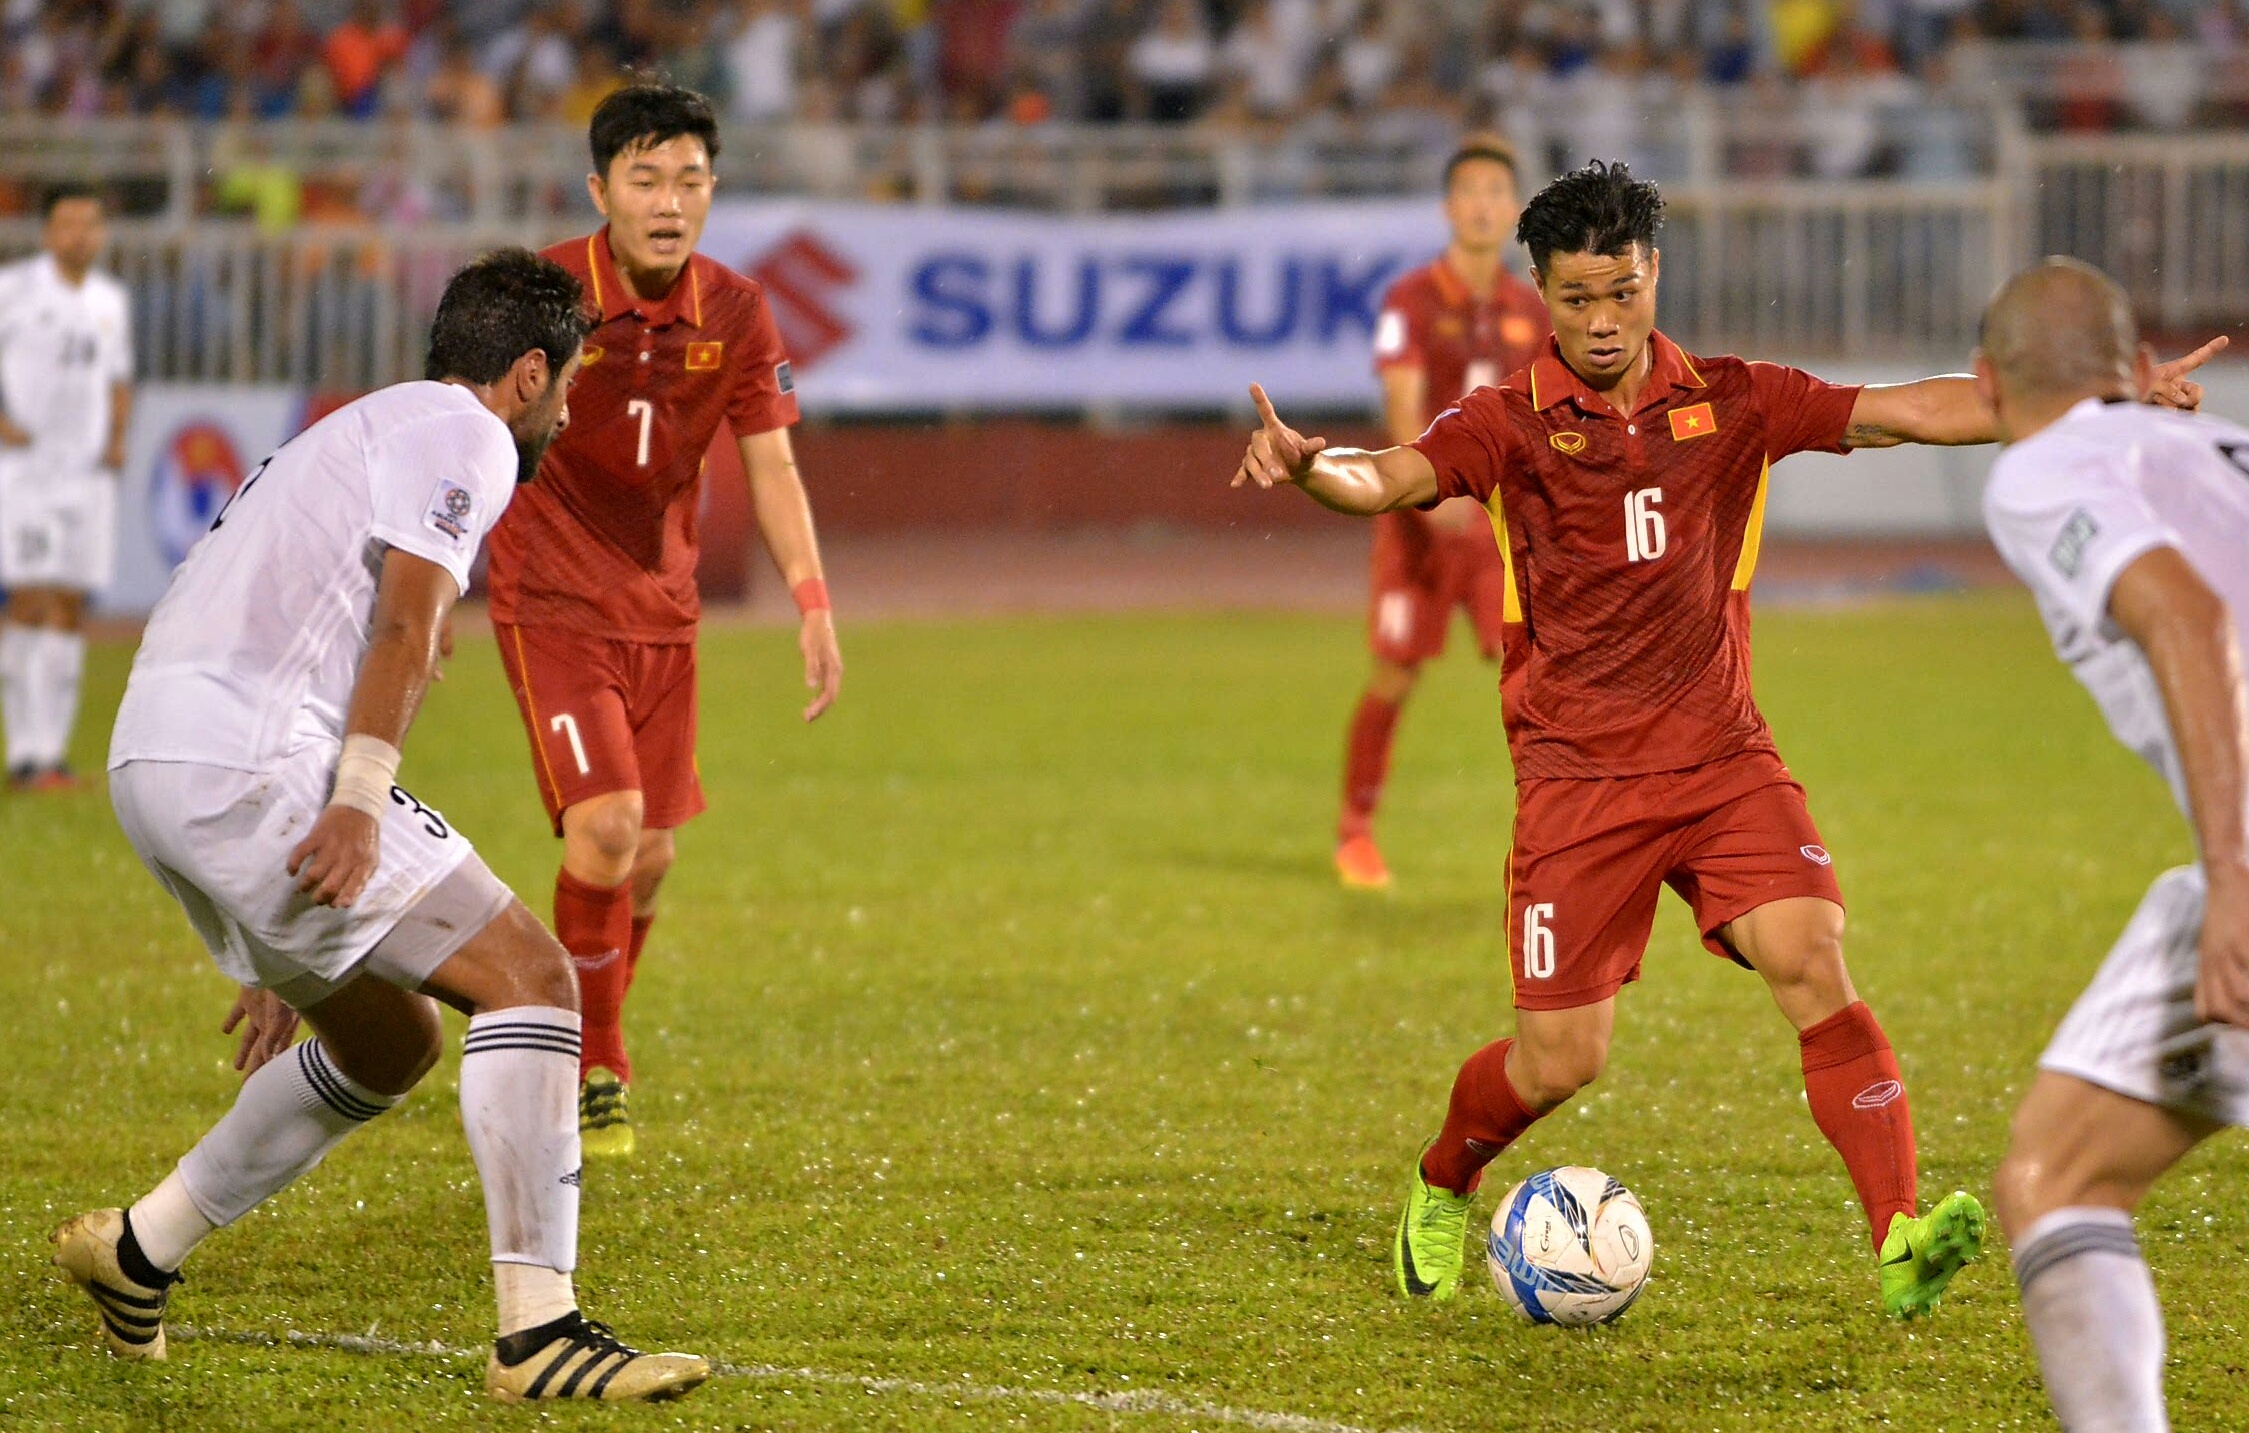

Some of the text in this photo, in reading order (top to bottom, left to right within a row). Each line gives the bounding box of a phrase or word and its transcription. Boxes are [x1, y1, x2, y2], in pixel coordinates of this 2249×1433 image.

[908, 248, 1405, 350] SUZUK
[627, 399, 652, 467] 7
[1623, 486, 1667, 562] 16
[549, 712, 590, 775] 7
[389, 785, 448, 839] 3
[1522, 902, 1556, 979] 16
